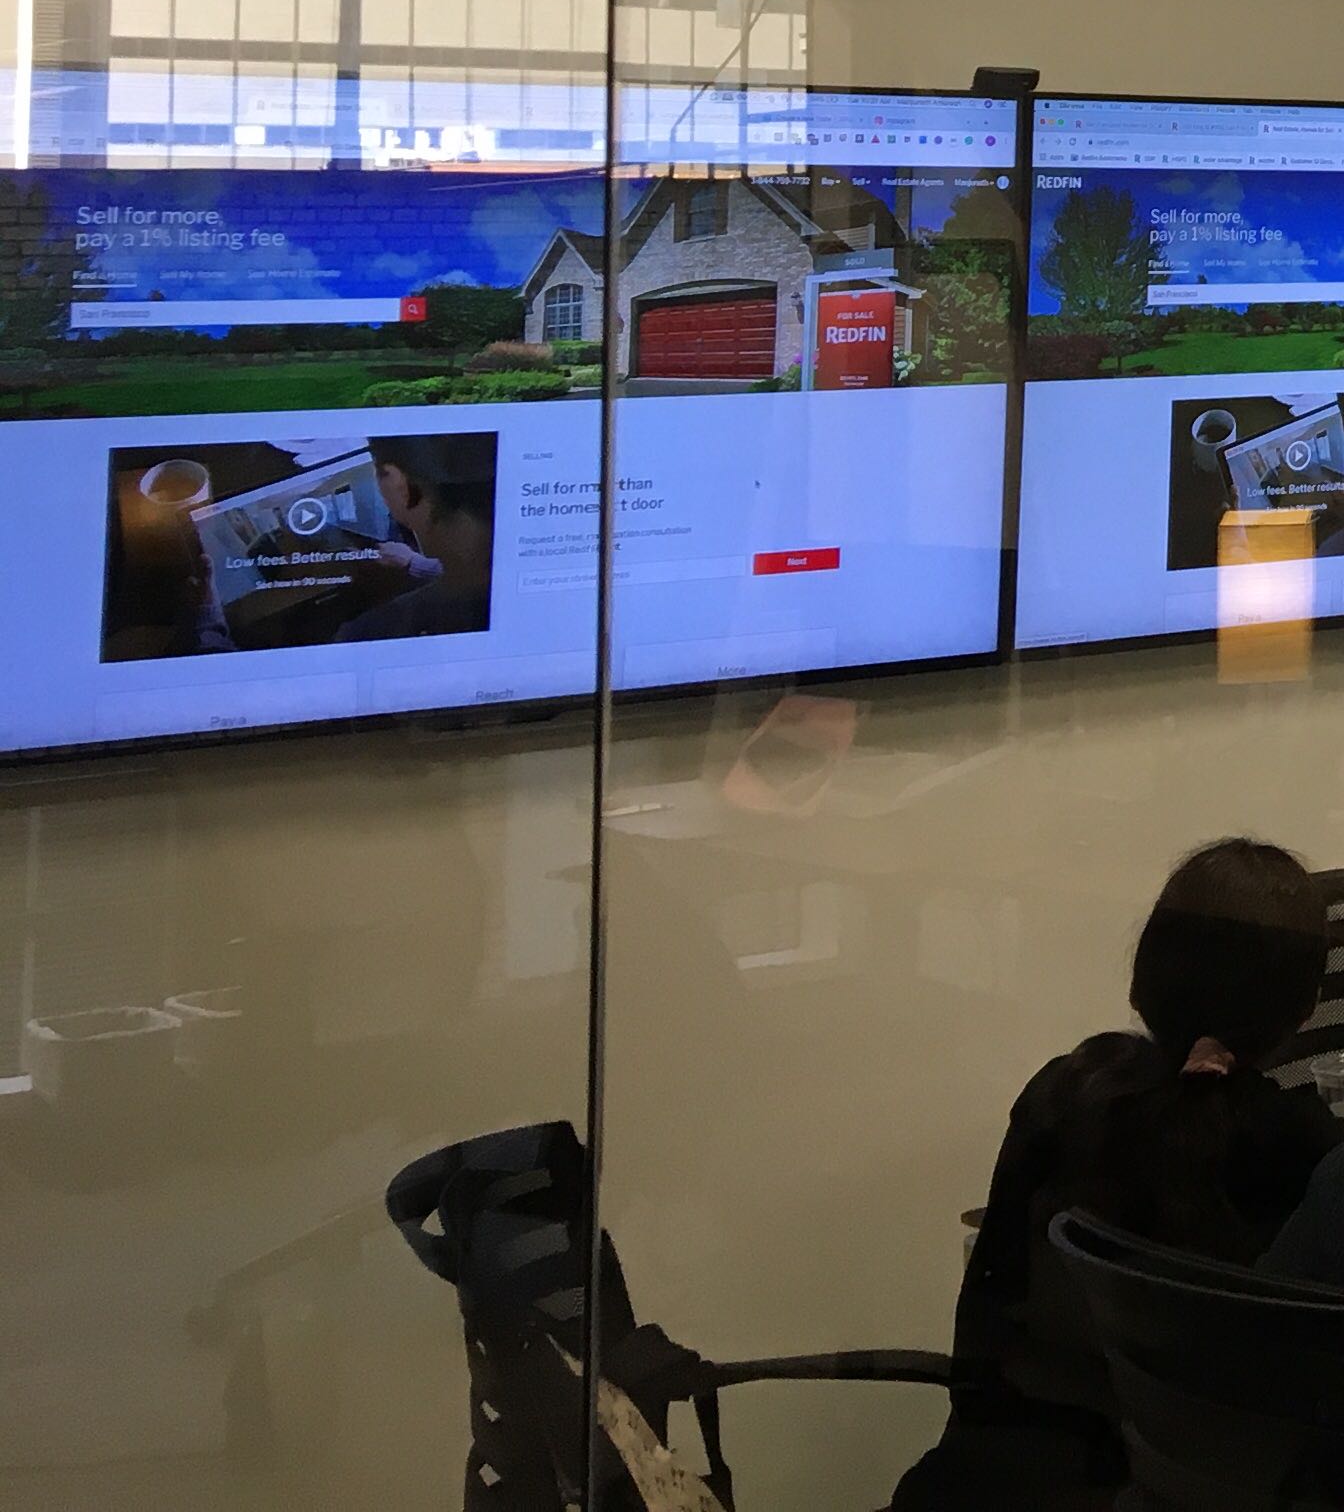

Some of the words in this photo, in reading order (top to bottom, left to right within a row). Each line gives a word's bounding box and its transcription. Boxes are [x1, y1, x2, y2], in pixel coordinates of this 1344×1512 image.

[76, 206, 118, 225] Sell
[124, 206, 157, 225] for
[1150, 208, 1177, 224] Sell
[1181, 208, 1201, 224] for
[75, 231, 118, 251] pay
[121, 231, 135, 247] a
[140, 228, 172, 248] 1%
[178, 229, 244, 251] listing
[250, 228, 286, 247] fee
[1149, 229, 1176, 245] pay
[1179, 230, 1188, 241] a
[1191, 226, 1213, 242] 1%
[1215, 226, 1257, 244] listing
[1259, 226, 1283, 241] fee
[825, 325, 887, 344] REDFIN
[520, 481, 550, 497] Sell
[553, 480, 576, 495] for
[618, 477, 653, 492] than
[1246, 487, 1266, 498] Low
[1288, 483, 1316, 495] Better
[520, 503, 546, 518] the
[631, 497, 665, 512] door
[225, 555, 256, 570] Low
[257, 553, 289, 567] fees.
[290, 551, 334, 565] Better
[334, 547, 383, 562] results.
